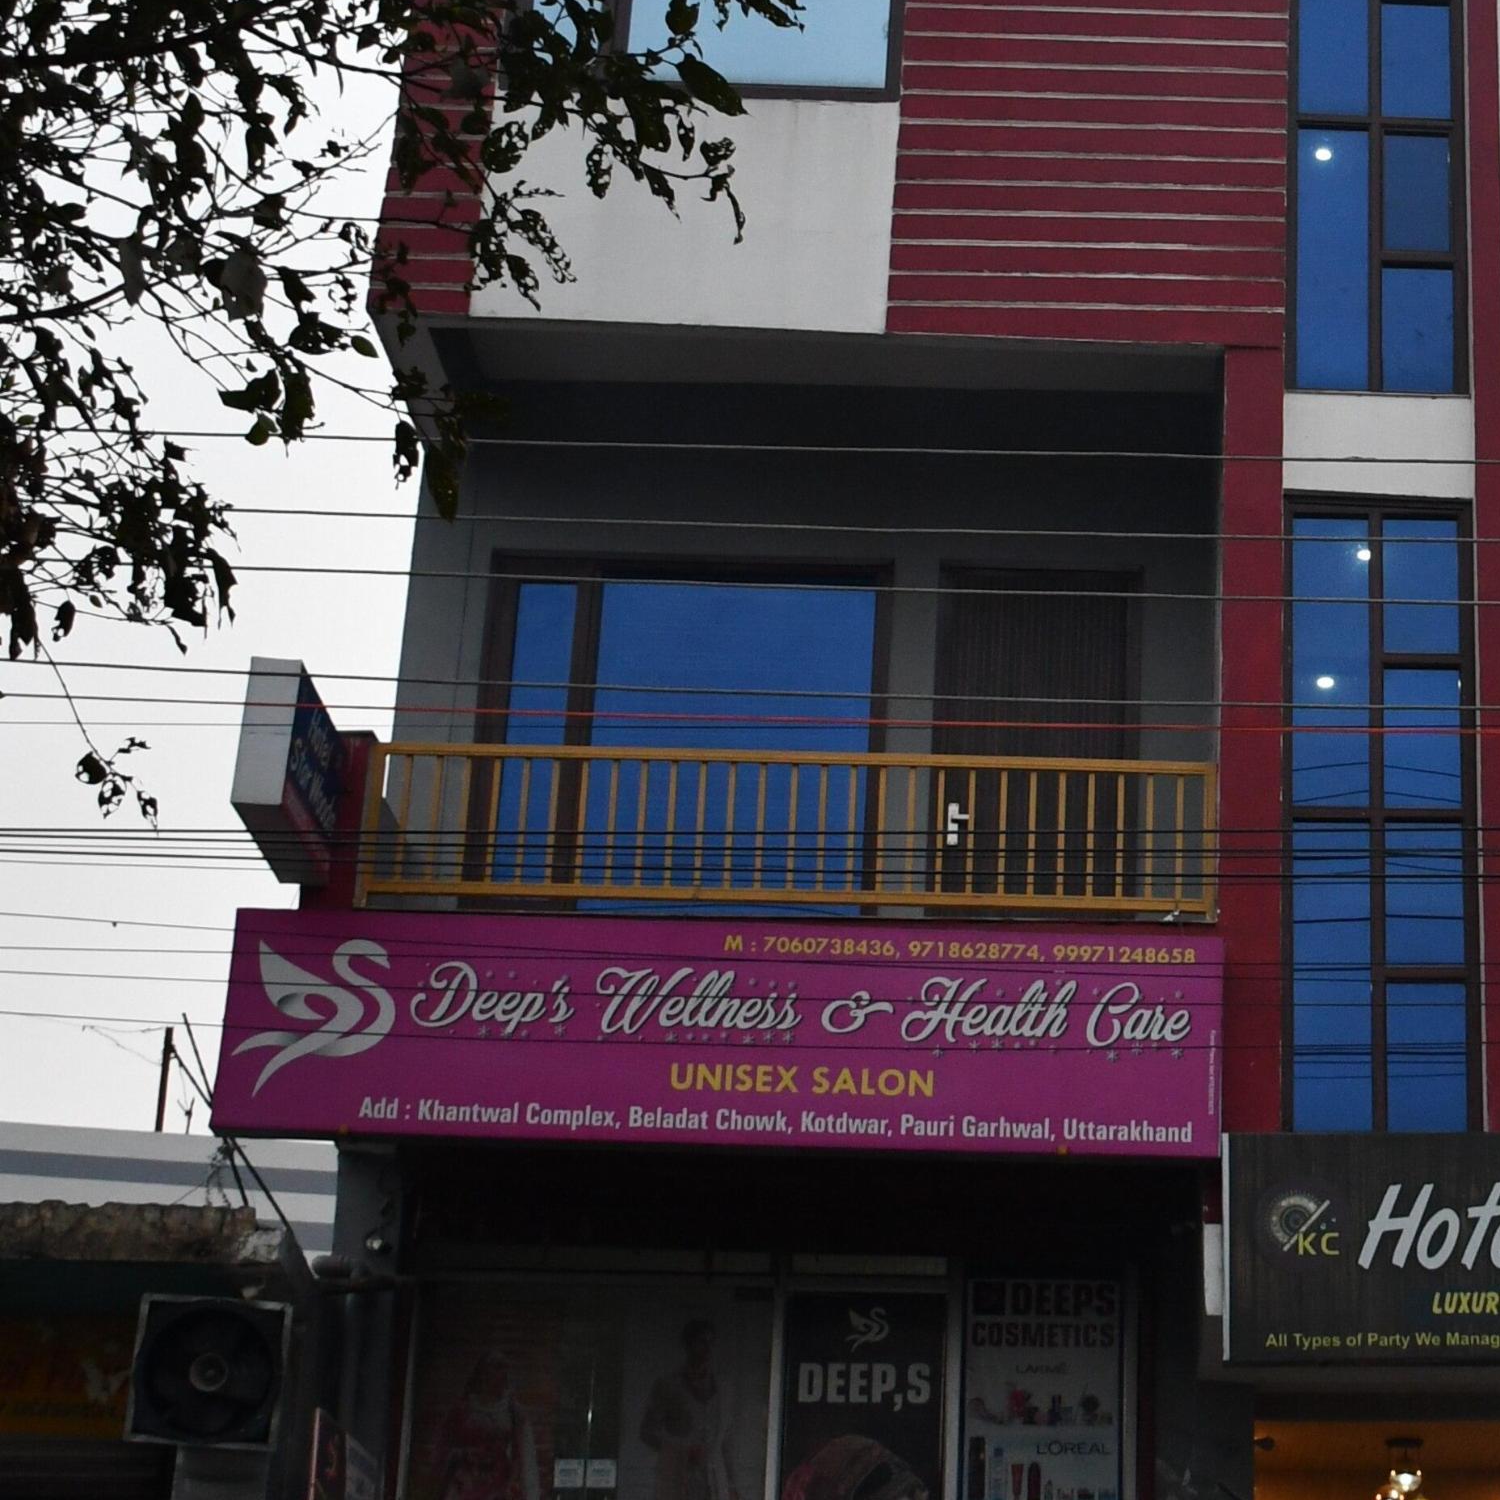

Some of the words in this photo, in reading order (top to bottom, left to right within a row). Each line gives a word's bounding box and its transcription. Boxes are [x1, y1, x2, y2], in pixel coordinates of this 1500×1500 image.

[724, 936, 744, 953] M
[763, 937, 900, 959] 7060738436,
[908, 941, 1045, 963] 9718628774,
[1053, 944, 1196, 965] 99971248658
[410, 961, 576, 1035] Deep's
[596, 967, 803, 1035] Wellness
[820, 991, 895, 1035] &
[900, 976, 1078, 1043] Health
[1086, 982, 1193, 1047] Care
[670, 1062, 799, 1093] UNISEX
[812, 1066, 935, 1097] SALON
[359, 1097, 398, 1120] Add
[418, 1100, 519, 1124] Khantwal
[526, 1103, 621, 1130] Complex,
[629, 1105, 708, 1130] Beladat
[716, 1108, 793, 1134] Chowk,
[801, 1111, 893, 1137] Kotdwar,
[900, 1114, 955, 1137] Pauri
[962, 1116, 1056, 1142] Garhwal,
[1063, 1118, 1194, 1143] Uttarakhand
[1296, 1232, 1341, 1256] KC
[1010, 1282, 1115, 1317] DEEPS
[972, 1322, 1115, 1349] COSMETICS
[1265, 1333, 1288, 1348] All
[1292, 1333, 1342, 1351] Types
[1346, 1333, 1363, 1348] of
[1367, 1333, 1410, 1350] Party
[1415, 1333, 1441, 1347] We
